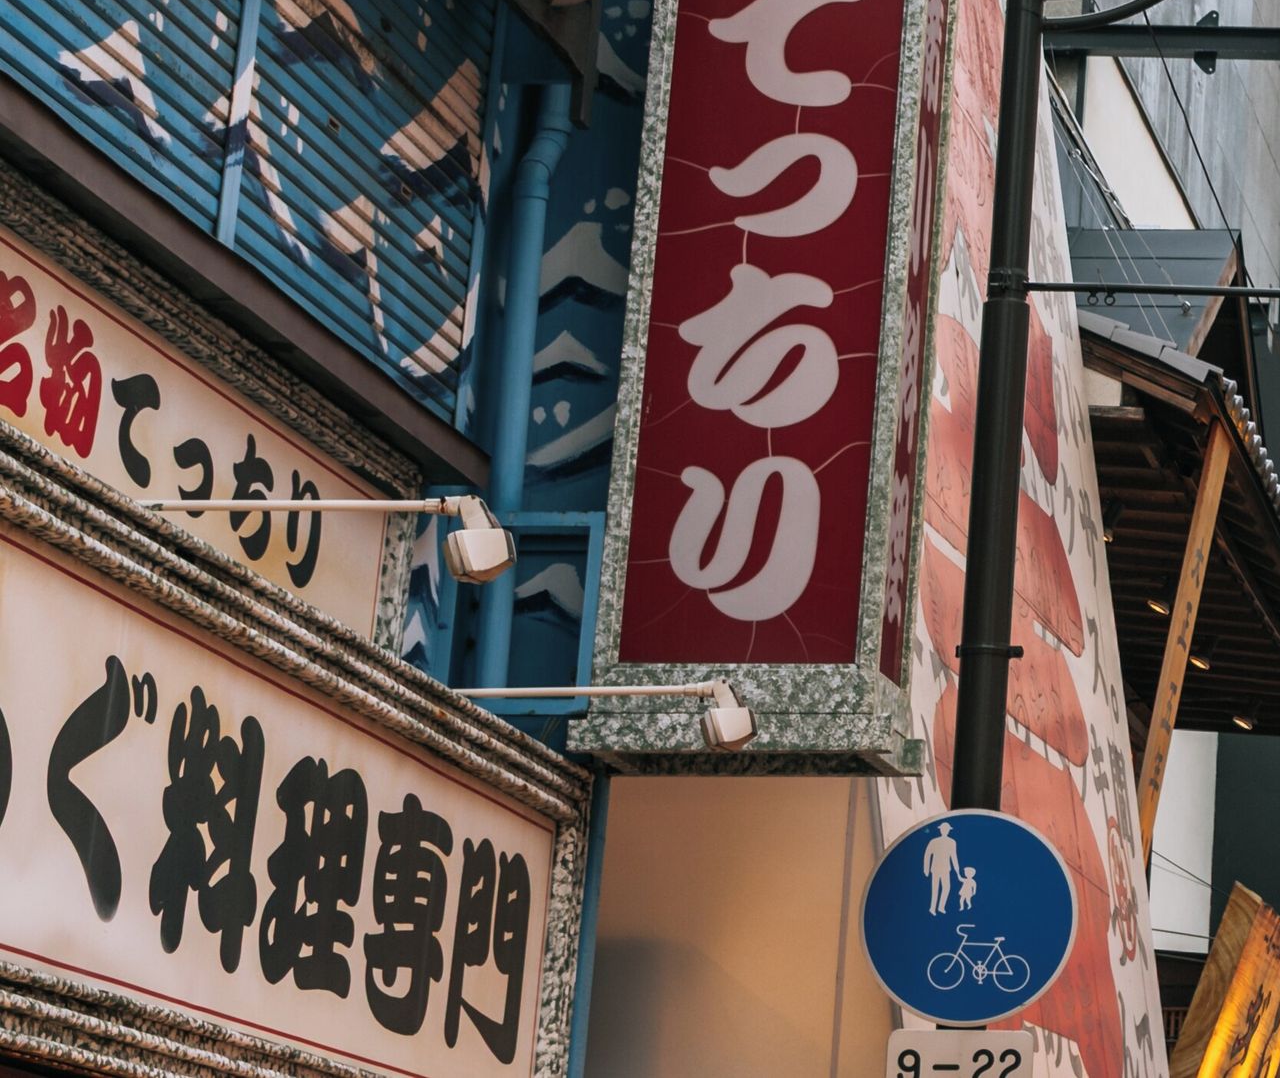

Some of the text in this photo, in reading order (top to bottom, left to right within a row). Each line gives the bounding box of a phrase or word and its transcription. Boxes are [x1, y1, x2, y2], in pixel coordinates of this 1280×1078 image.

[0, 655, 531, 1064] ぐ料理専門
